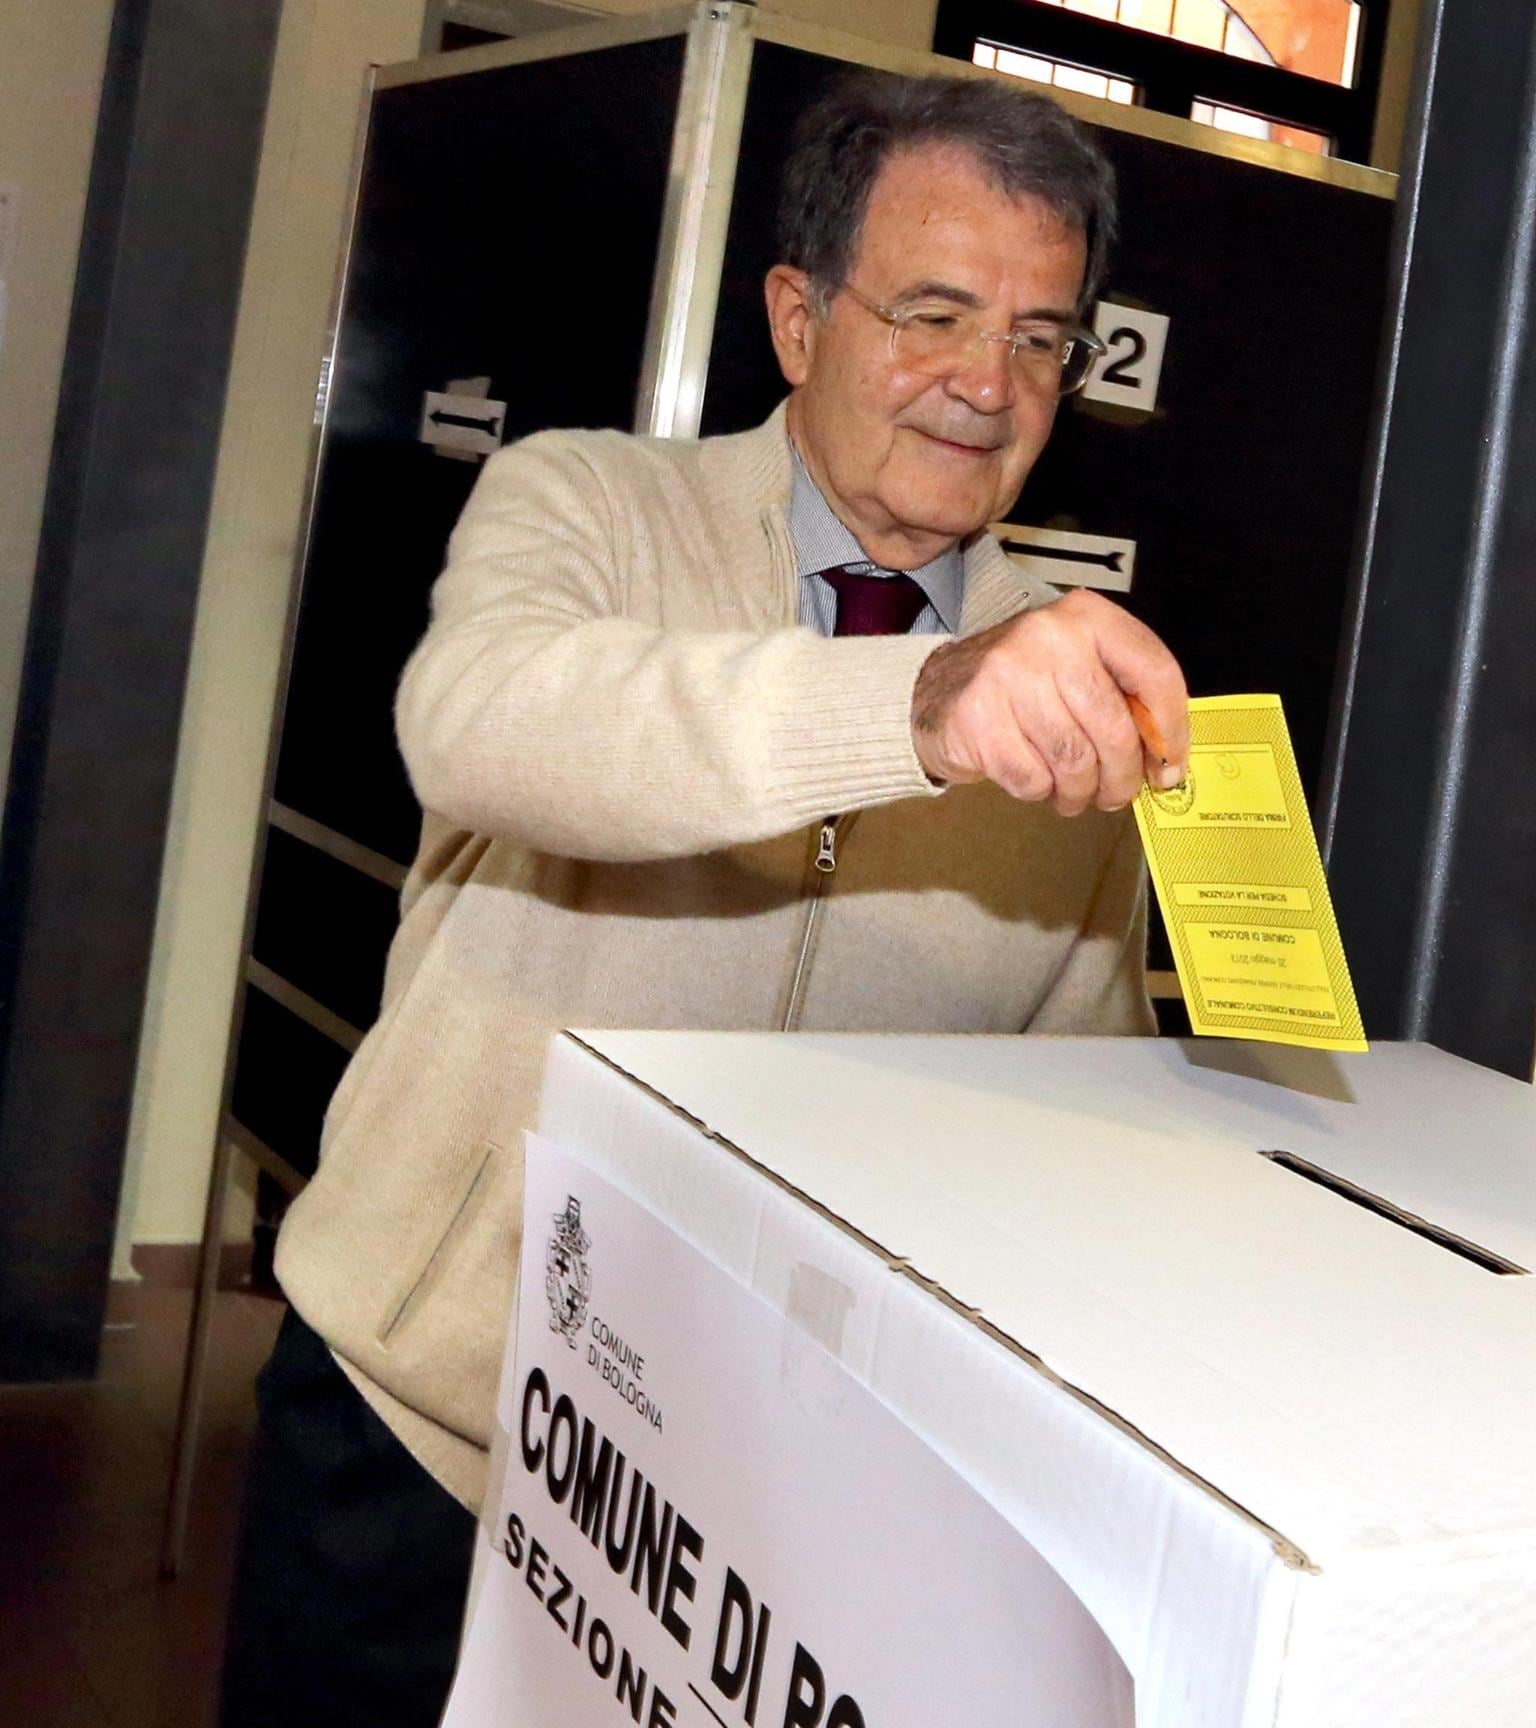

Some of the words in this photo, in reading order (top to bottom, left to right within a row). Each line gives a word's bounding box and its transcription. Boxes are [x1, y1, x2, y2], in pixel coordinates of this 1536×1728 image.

[1102, 327, 1147, 389] 2
[1208, 930, 1250, 941] BOLOGNA
[1251, 932, 1260, 941] DI
[1261, 932, 1296, 944] COMUNE
[591, 1316, 645, 1381] COMUNE
[587, 1343, 601, 1372] DI
[602, 1357, 663, 1435] BOLOGNA
[520, 1367, 705, 1652] COMUNE
[710, 1565, 772, 1728] DI
